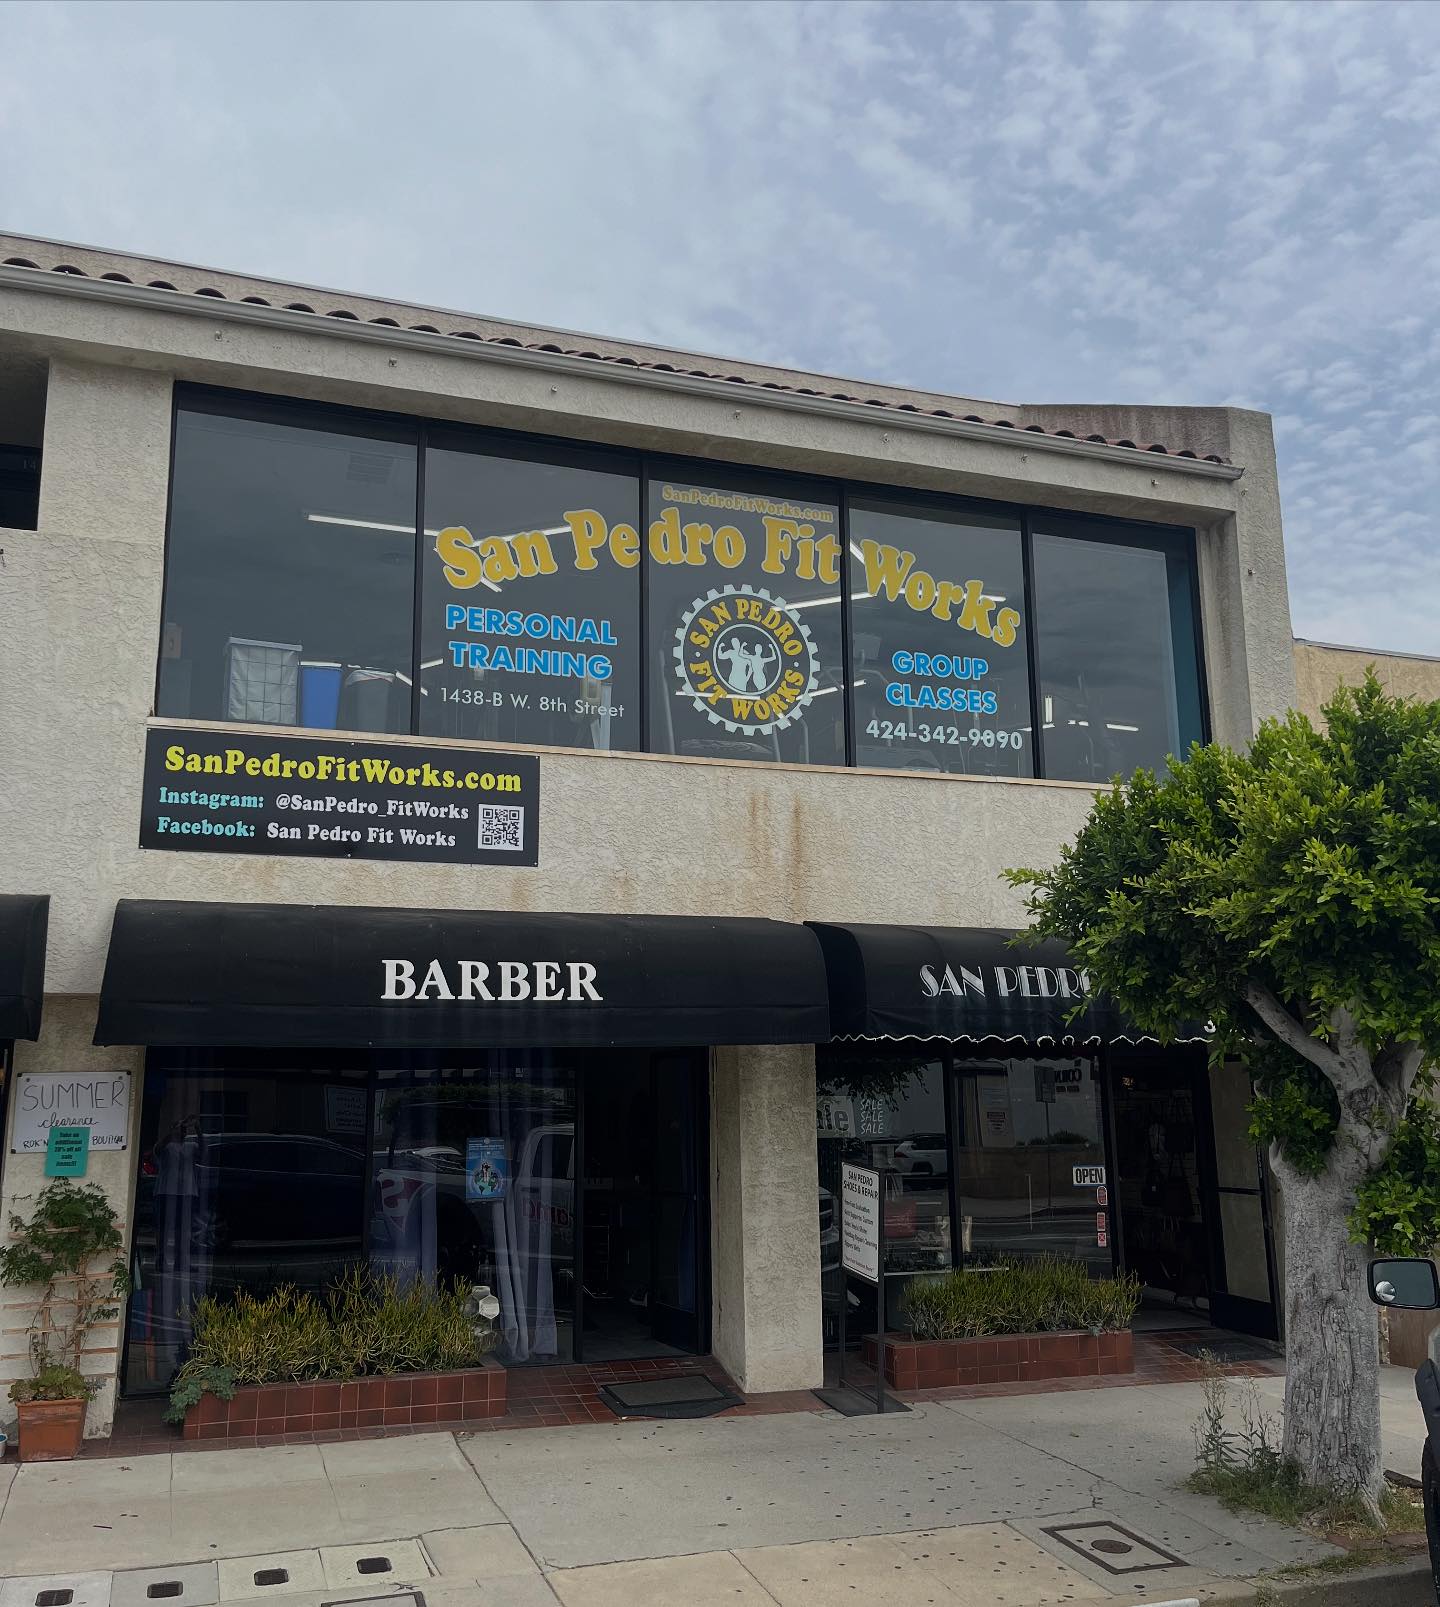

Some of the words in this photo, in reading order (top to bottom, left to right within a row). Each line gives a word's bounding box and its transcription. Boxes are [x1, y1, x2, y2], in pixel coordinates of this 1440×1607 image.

[661, 484, 834, 523] SanPedroFitWorks.com
[436, 525, 558, 590] San
[563, 506, 747, 570] Pedro
[761, 515, 842, 584] Fit
[860, 539, 1021, 647] Works
[445, 604, 618, 645] PERSONAL
[690, 601, 732, 649] SAN
[735, 598, 803, 656] PEDRO
[448, 641, 613, 680] TRAINING
[892, 650, 989, 680] GROUP
[440, 687, 503, 707] 1438-B
[510, 693, 531, 710] W.
[539, 696, 567, 713] 8th
[574, 699, 625, 718] Street
[690, 660, 729, 706] FIT
[731, 669, 805, 720] WORKS
[886, 682, 998, 714] CLASSES
[865, 719, 1023, 750] 424-342-9090
[164, 745, 522, 792] SanPedroFitWorks.com
[159, 786, 264, 809] Instagram:
[275, 793, 470, 820] @SanPedro_FitWorks
[156, 816, 256, 838] Facebook:
[266, 822, 301, 840] San
[307, 824, 362, 843] Pedro
[367, 827, 393, 844] Fit
[400, 829, 456, 847] Works
[380, 958, 604, 1001] BARBER
[919, 963, 986, 998] SAN
[22, 1080, 125, 1112] SUMMER
[860, 1099, 883, 1111] SALE
[860, 1111, 884, 1122] SALE
[860, 1122, 884, 1135] SALE
[858, 1173, 873, 1187] PEDRO
[1075, 1167, 1104, 1184] OPEN
